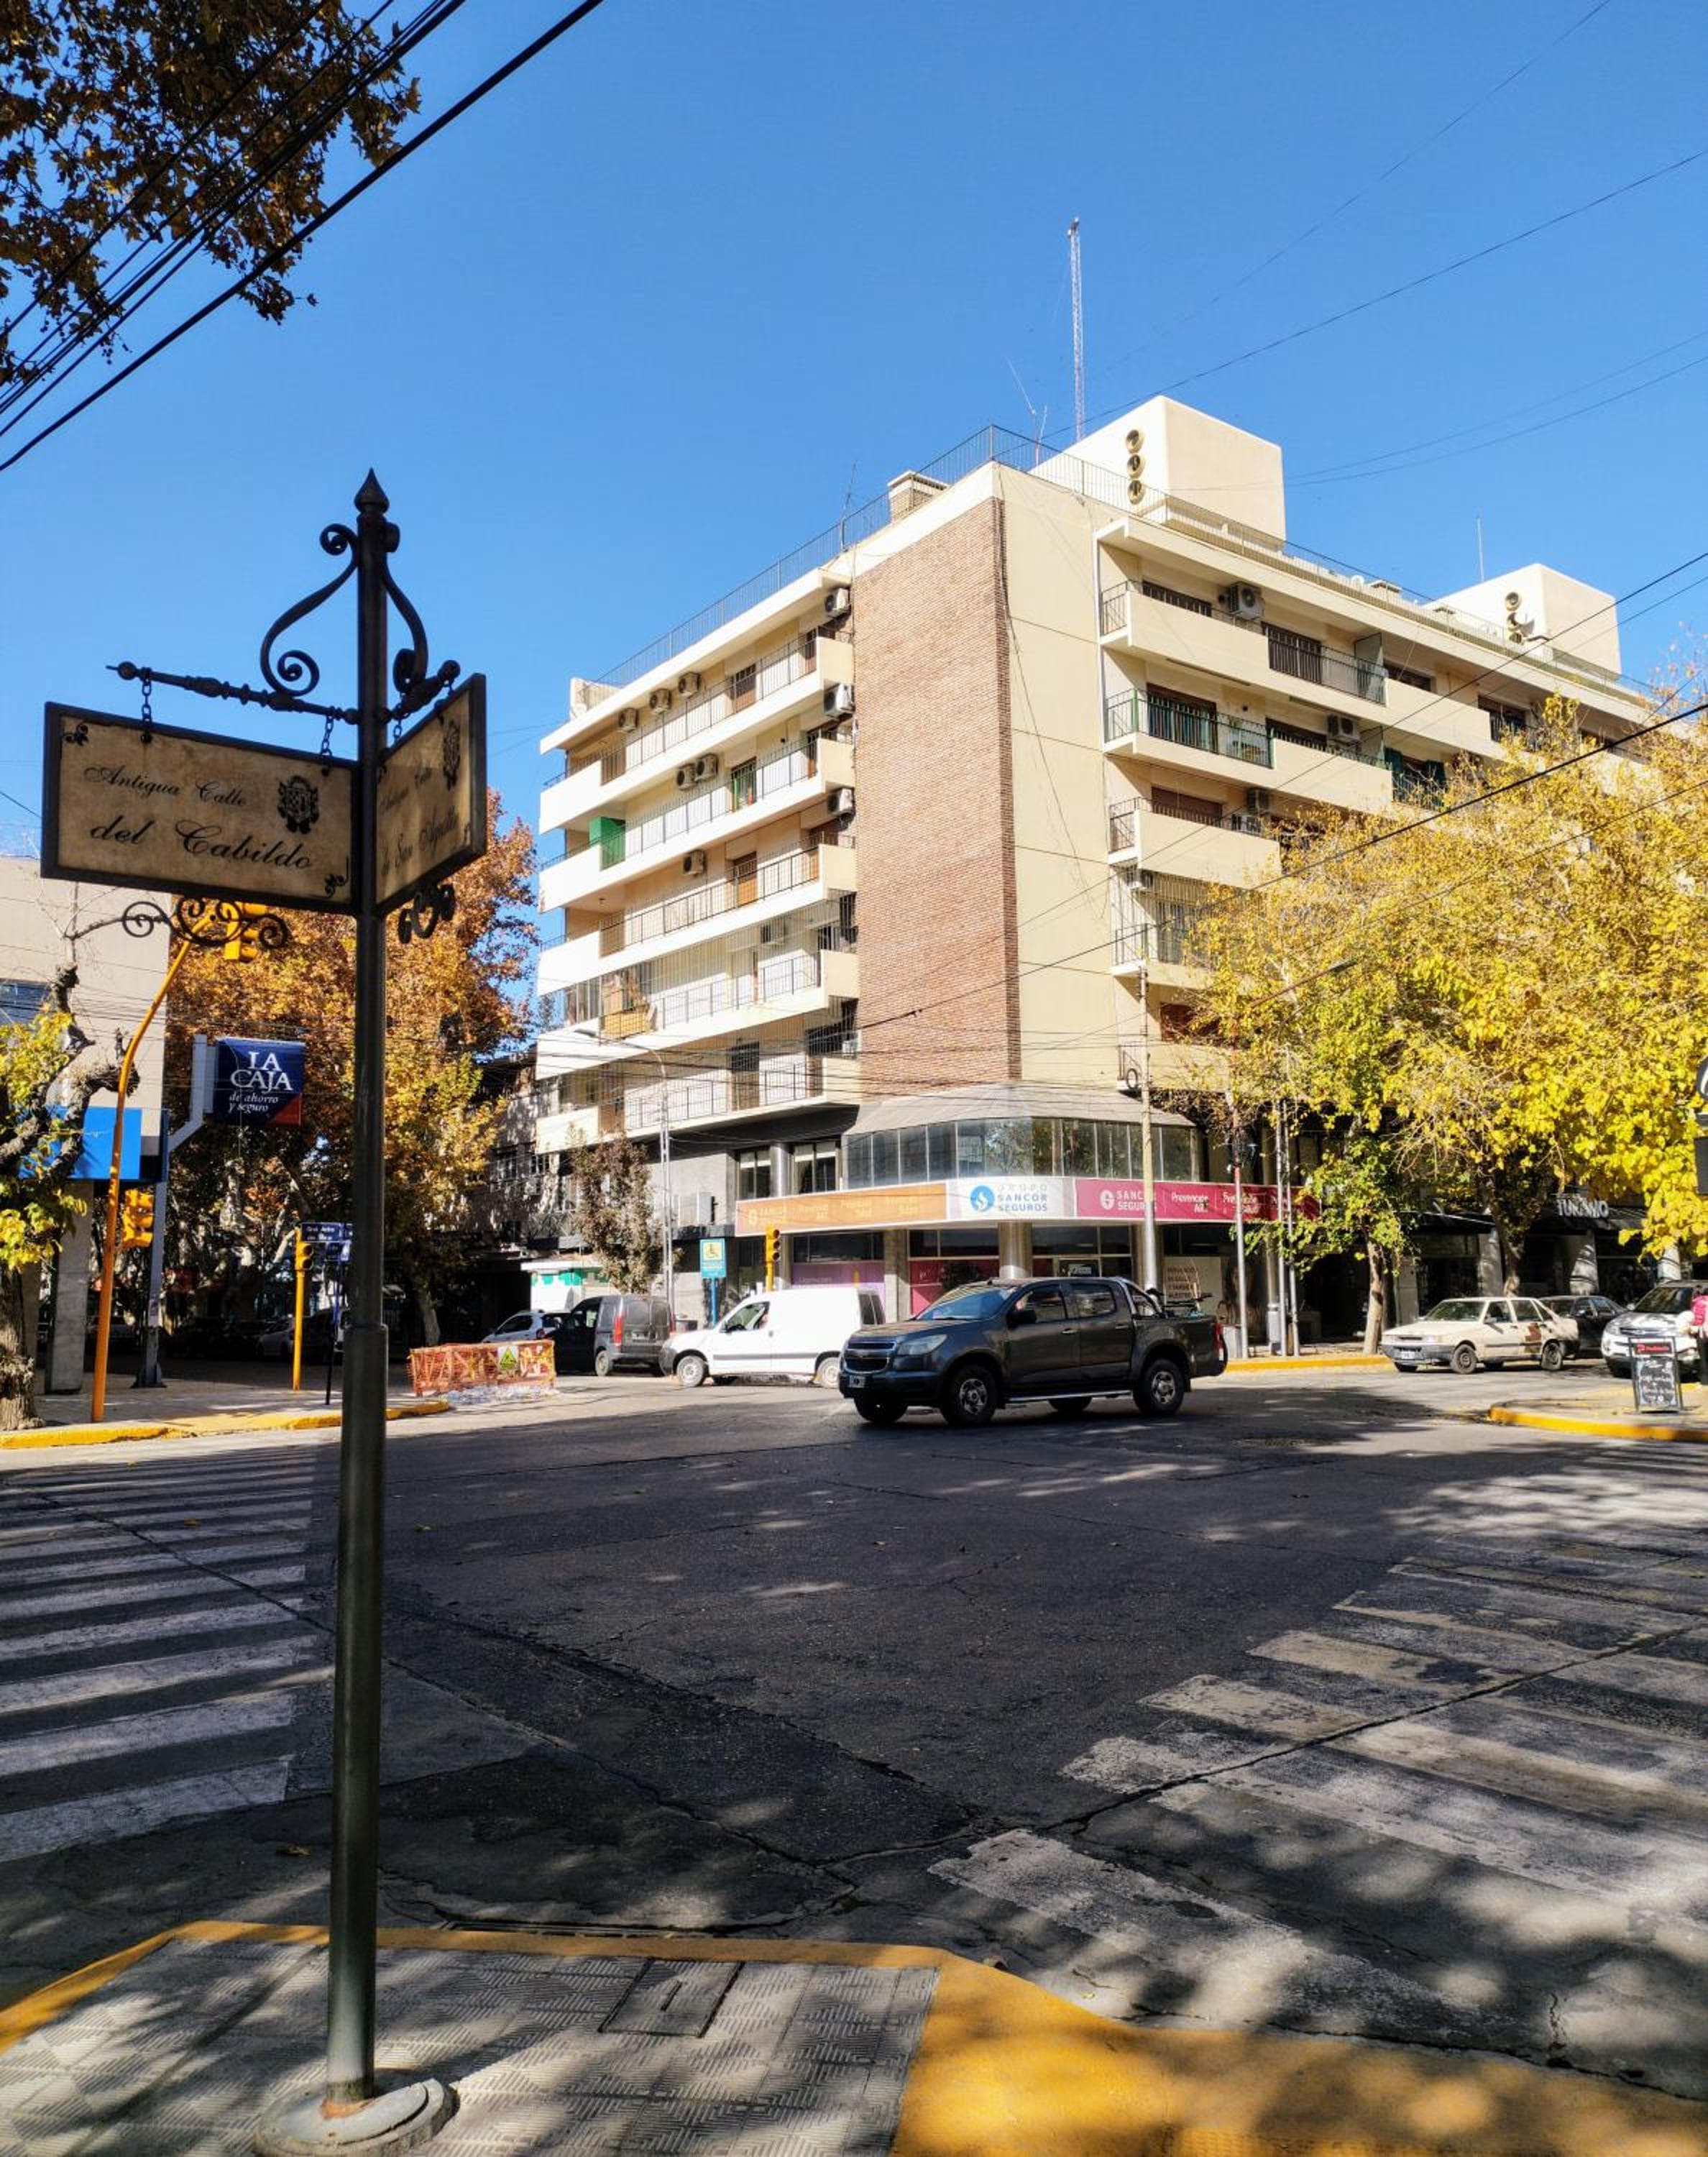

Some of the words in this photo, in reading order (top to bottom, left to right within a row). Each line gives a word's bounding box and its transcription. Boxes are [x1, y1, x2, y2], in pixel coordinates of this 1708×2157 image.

[83, 764, 180, 799] Antigua
[195, 781, 247, 806] Calle
[90, 815, 156, 844] del
[175, 820, 313, 869] Cabildo
[247, 1050, 283, 1072] LA
[230, 1068, 293, 1094] CAJA
[229, 1091, 240, 1102] de
[244, 1092, 279, 1104] ahorro
[228, 1102, 236, 1114] y
[237, 1104, 269, 1114] seguro
[998, 1193, 1047, 1201] SANCOR
[998, 1203, 1047, 1212] SEGUROS
